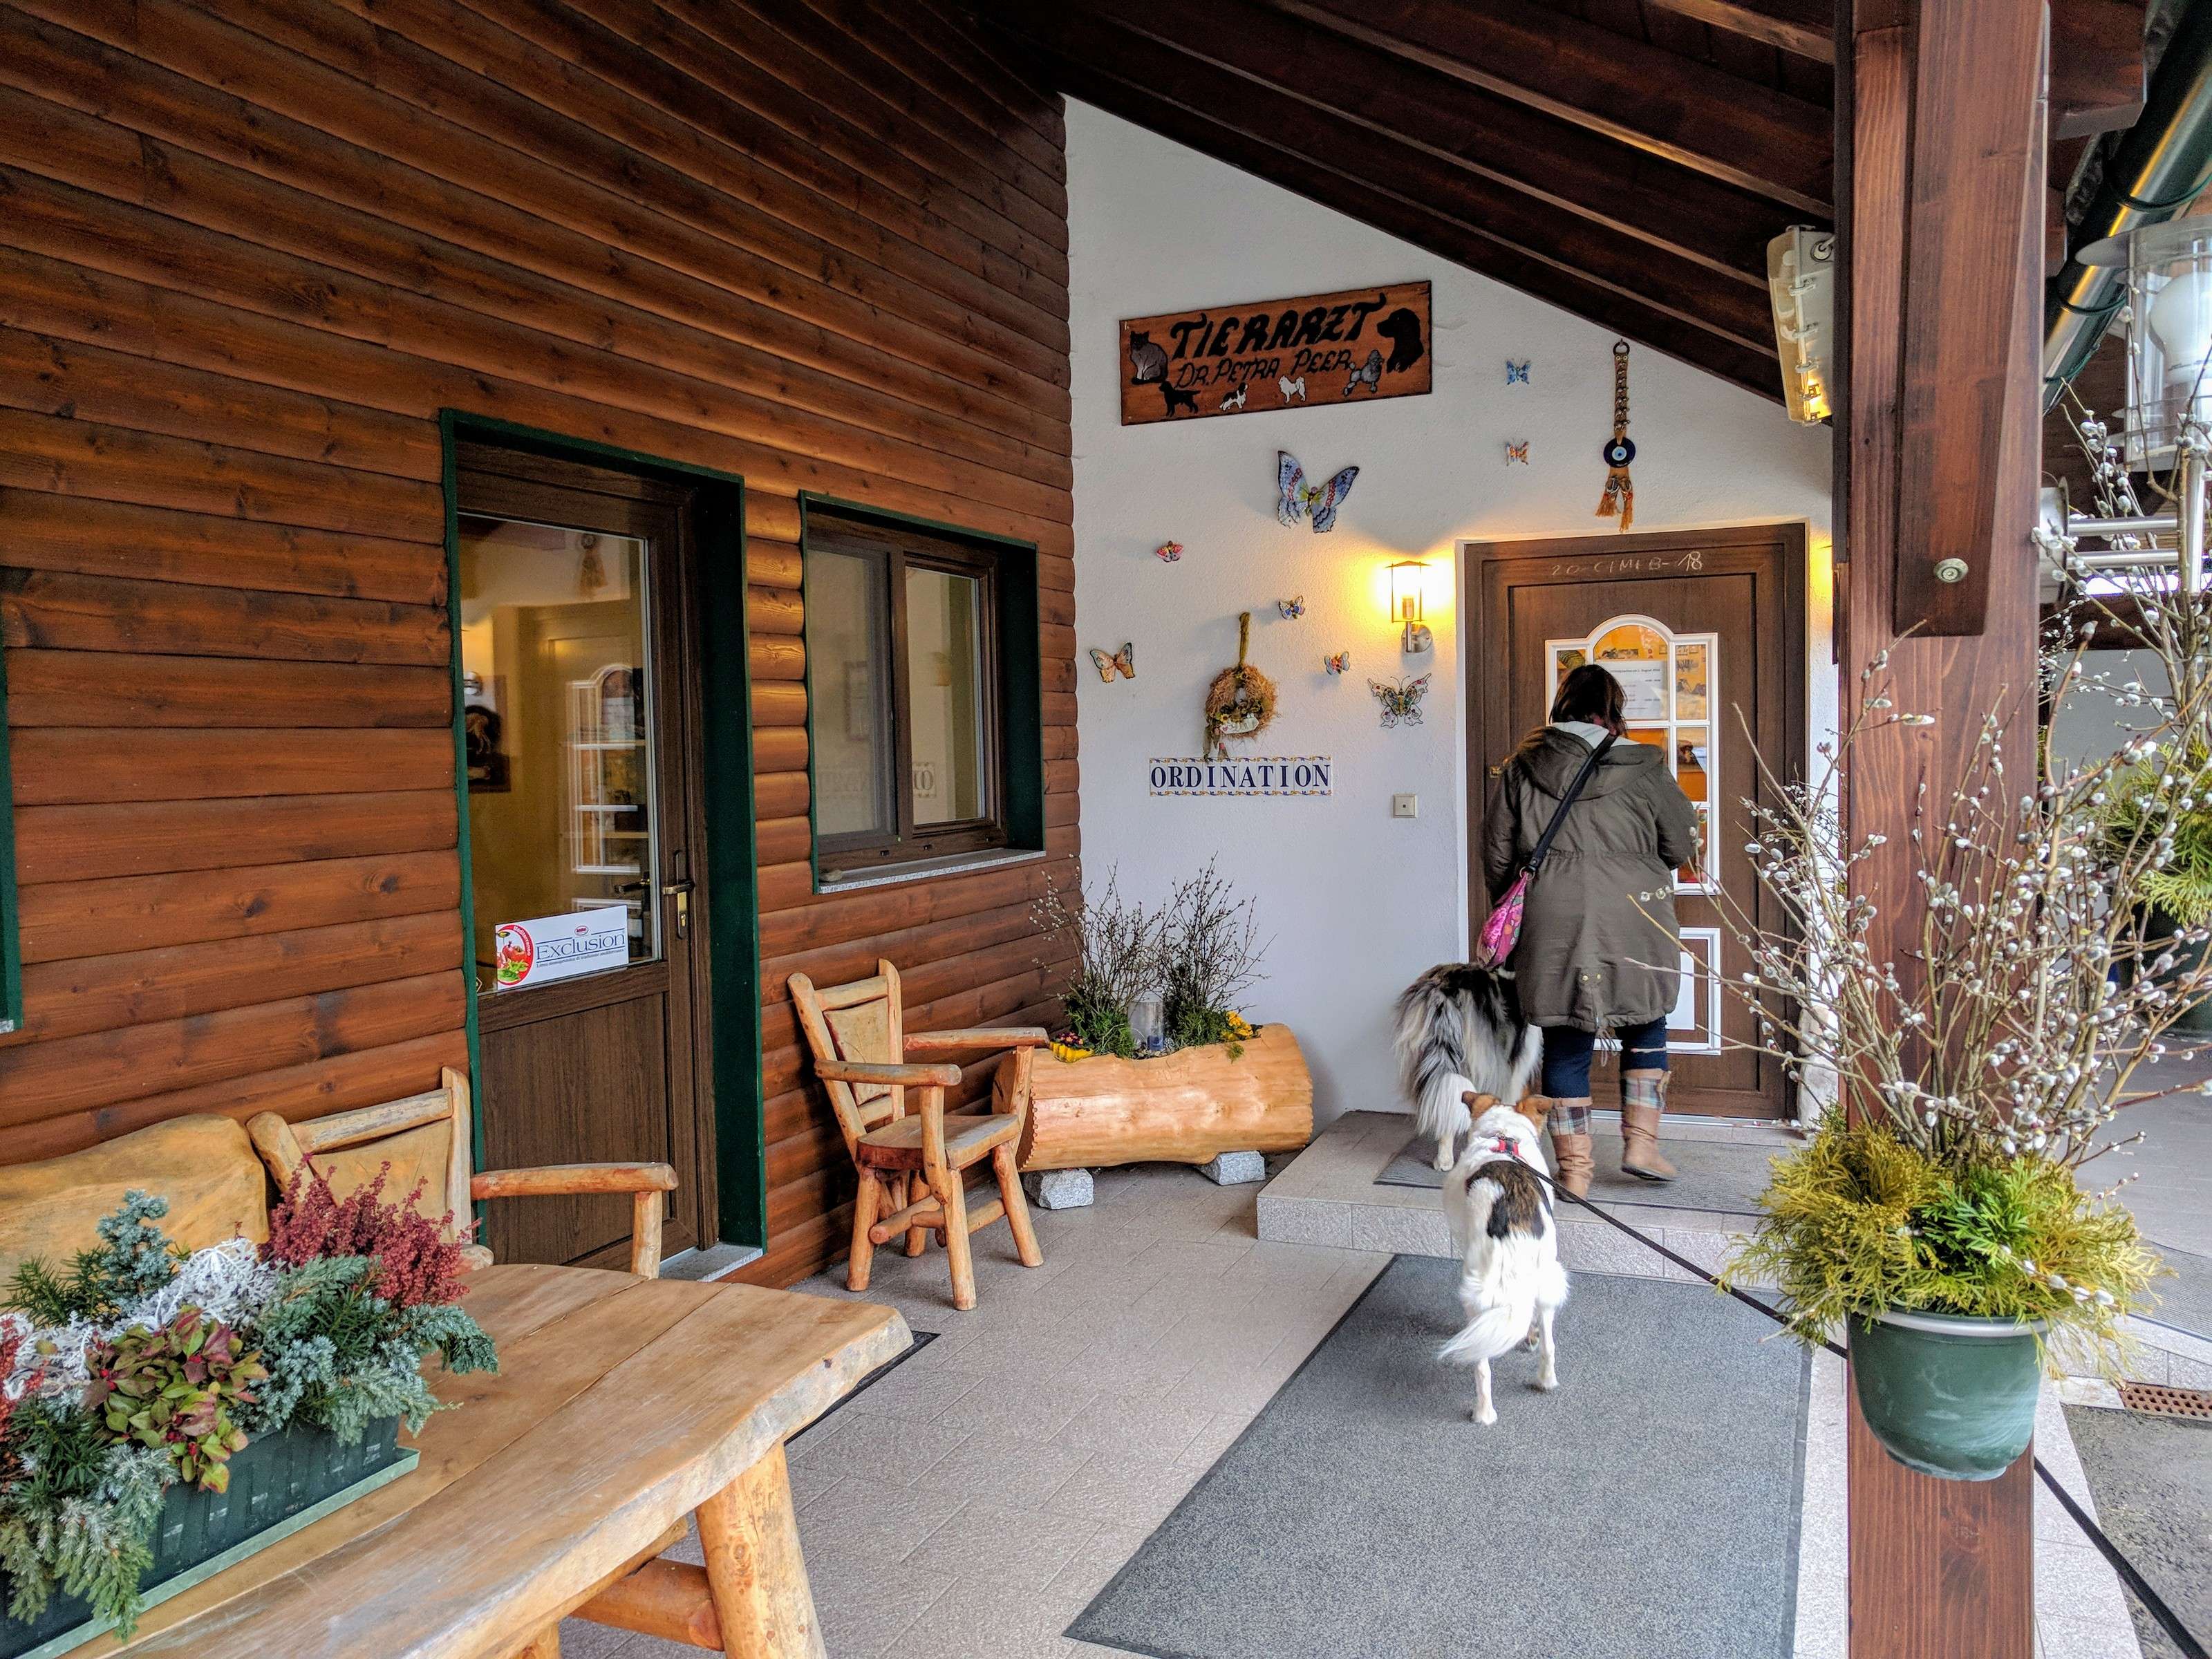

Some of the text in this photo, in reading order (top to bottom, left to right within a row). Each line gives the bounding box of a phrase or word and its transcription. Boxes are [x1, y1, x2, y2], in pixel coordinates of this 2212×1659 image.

[1170, 293, 1387, 361] TIERARZT
[1174, 349, 1353, 388] DR. PETRA PEER
[1151, 765, 1330, 788] ORDINATION
[536, 933, 625, 959] Exclusion
